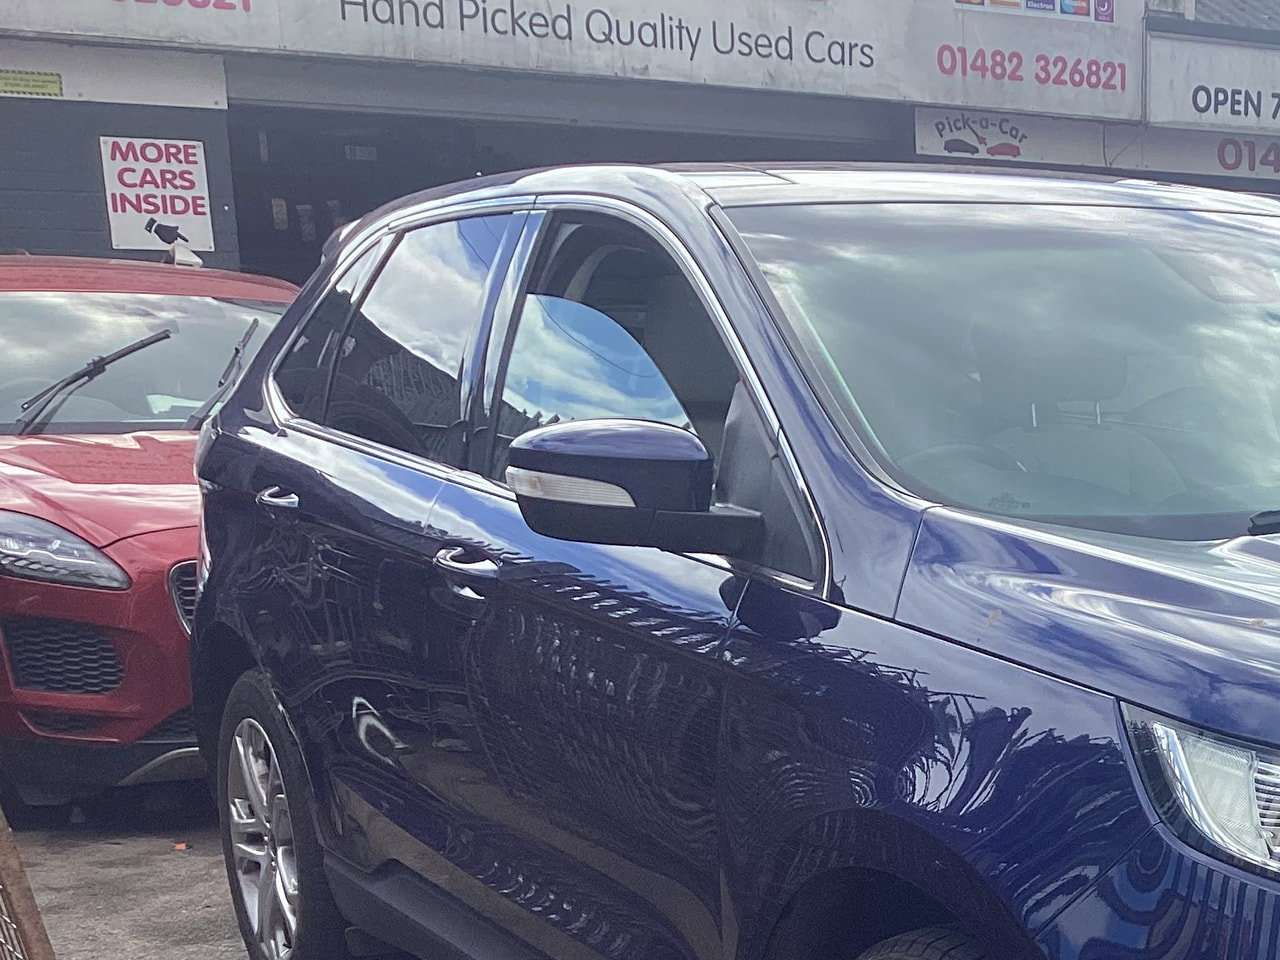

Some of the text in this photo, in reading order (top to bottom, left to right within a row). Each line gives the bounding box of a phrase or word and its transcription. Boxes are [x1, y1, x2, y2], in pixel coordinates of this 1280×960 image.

[340, 0, 875, 69] Hand Picked Quality Used Cars
[936, 44, 1127, 91] 01482 326821
[1192, 85, 1262, 118] OPEN
[935, 113, 1028, 143] Pick-a-Car
[110, 141, 198, 165] MORE
[117, 167, 196, 191] CARS
[112, 192, 207, 217] INSIDE
